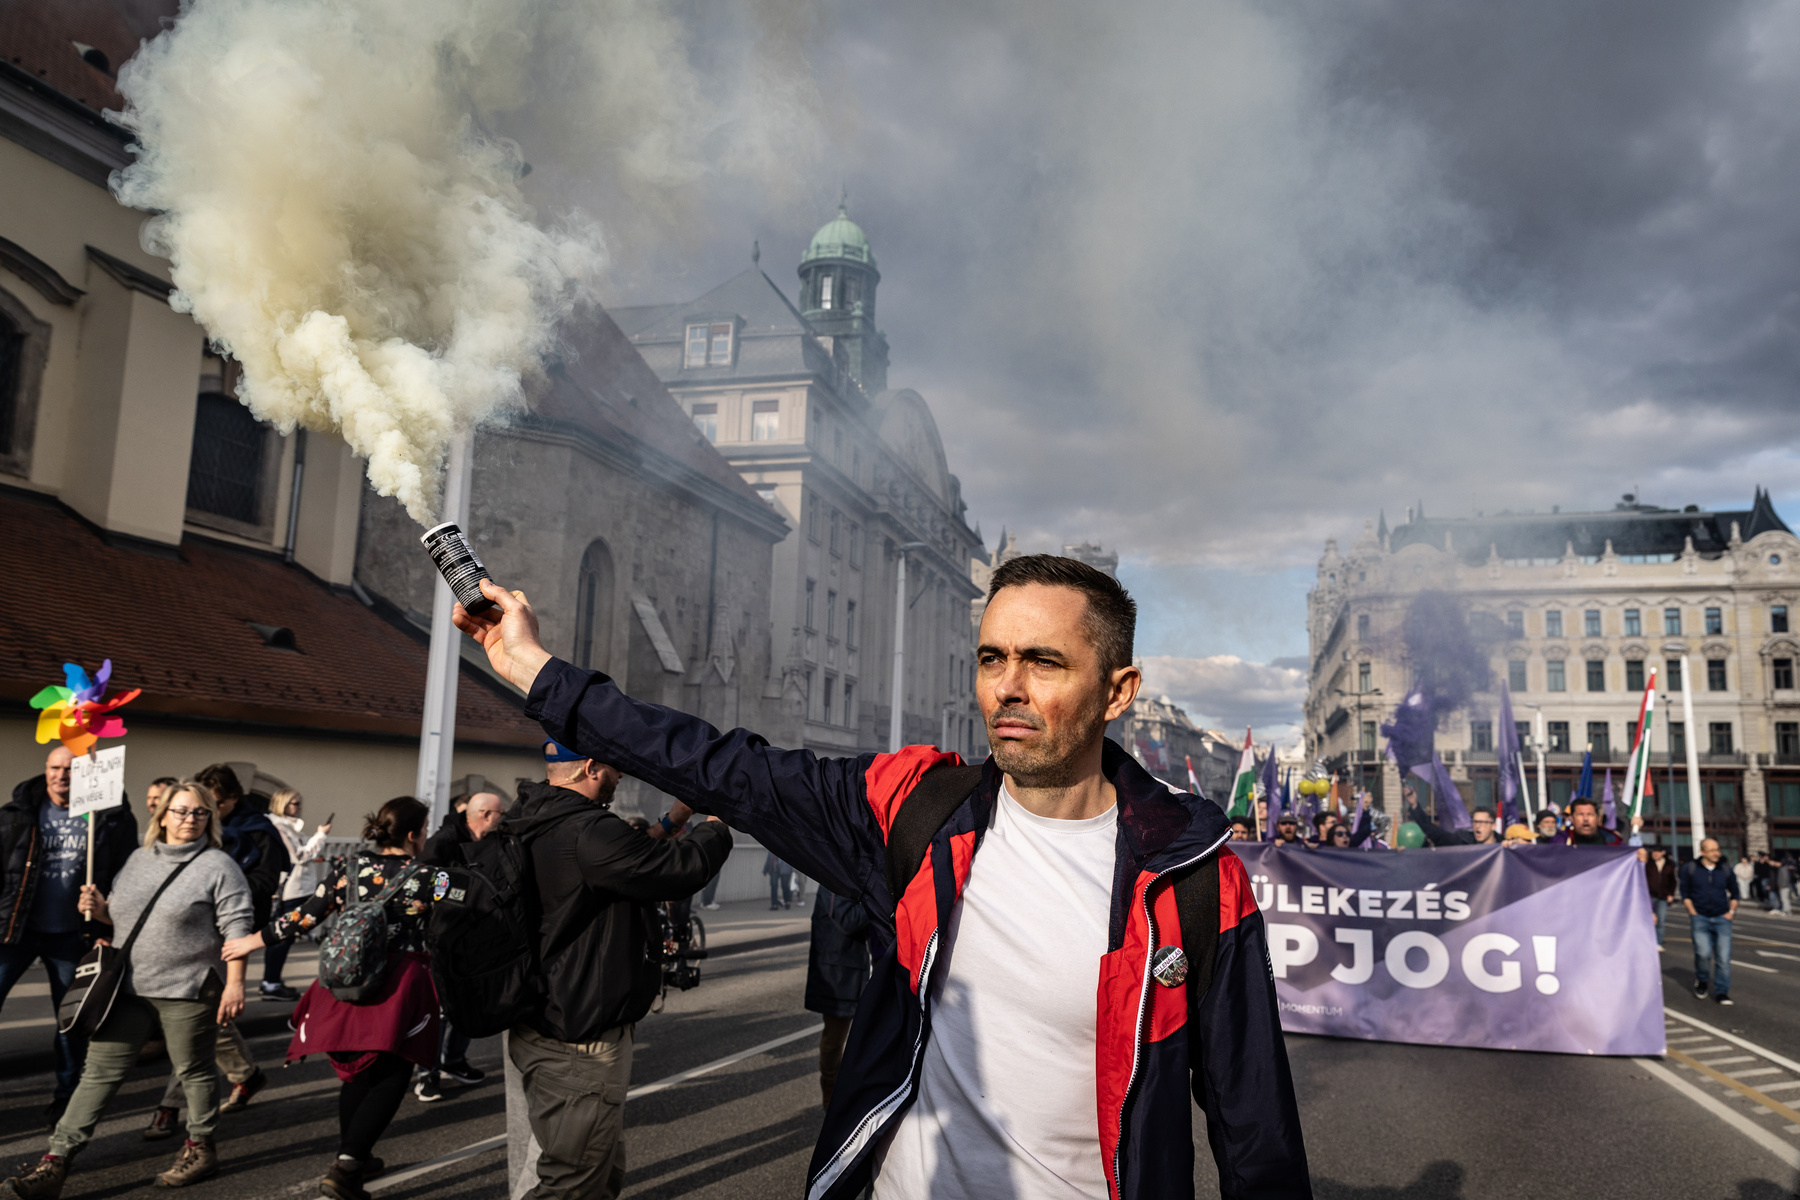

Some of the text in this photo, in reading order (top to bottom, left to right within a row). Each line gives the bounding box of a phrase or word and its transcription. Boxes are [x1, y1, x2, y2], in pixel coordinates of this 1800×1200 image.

[1251, 875, 1471, 921] ÜLEKEZÉS
[1267, 923, 1560, 995] PJOG!
[1281, 1001, 1343, 1016] MOMENTUM
